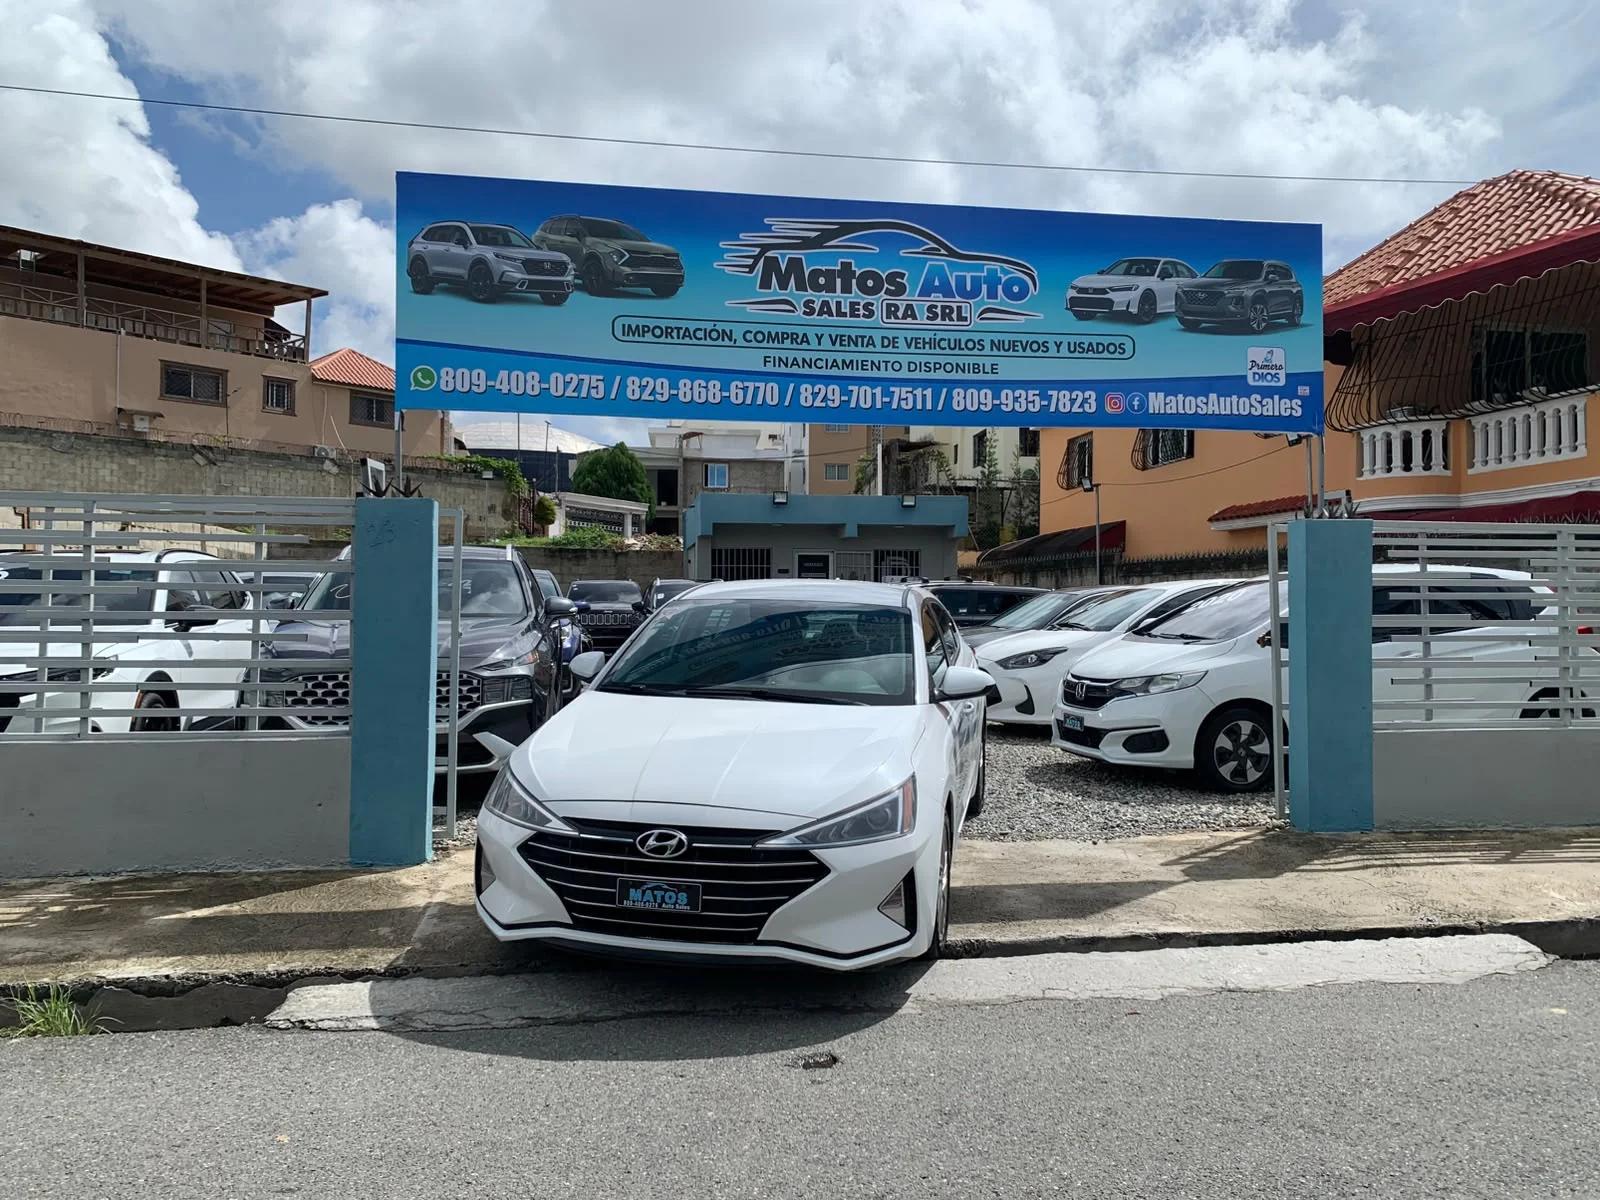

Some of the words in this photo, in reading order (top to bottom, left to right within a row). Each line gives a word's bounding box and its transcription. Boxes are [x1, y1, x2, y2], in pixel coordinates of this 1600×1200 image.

[757, 255, 909, 298] Matos
[916, 261, 1031, 302] Auto
[802, 300, 876, 320] SALES
[885, 302, 919, 321] RA
[926, 305, 969, 323] SRL
[621, 323, 737, 344] IMPORTACIÓN,
[742, 330, 811, 346] COMPRA
[814, 333, 825, 346] Y
[829, 333, 876, 348] VENTA
[880, 336, 900, 349] DE
[903, 333, 985, 351] VEHÍCULOS
[989, 339, 1049, 353] NUEVOS
[1054, 341, 1064, 354] Y
[1067, 341, 1126, 355] USADOS
[763, 356, 903, 372] FINANCIAMIENTO
[907, 362, 999, 375] DISPONIBLE
[1248, 360, 1284, 371] Primero
[1252, 372, 1280, 383] DIOS
[440, 367, 605, 399] 809-408-0275
[626, 376, 779, 406] 829-868-6770
[800, 384, 933, 410] 829-701-7511
[952, 388, 1097, 413] 809-935-7823
[1148, 392, 1302, 417] MatosAutoSales
[629, 888, 688, 905] MATOS
